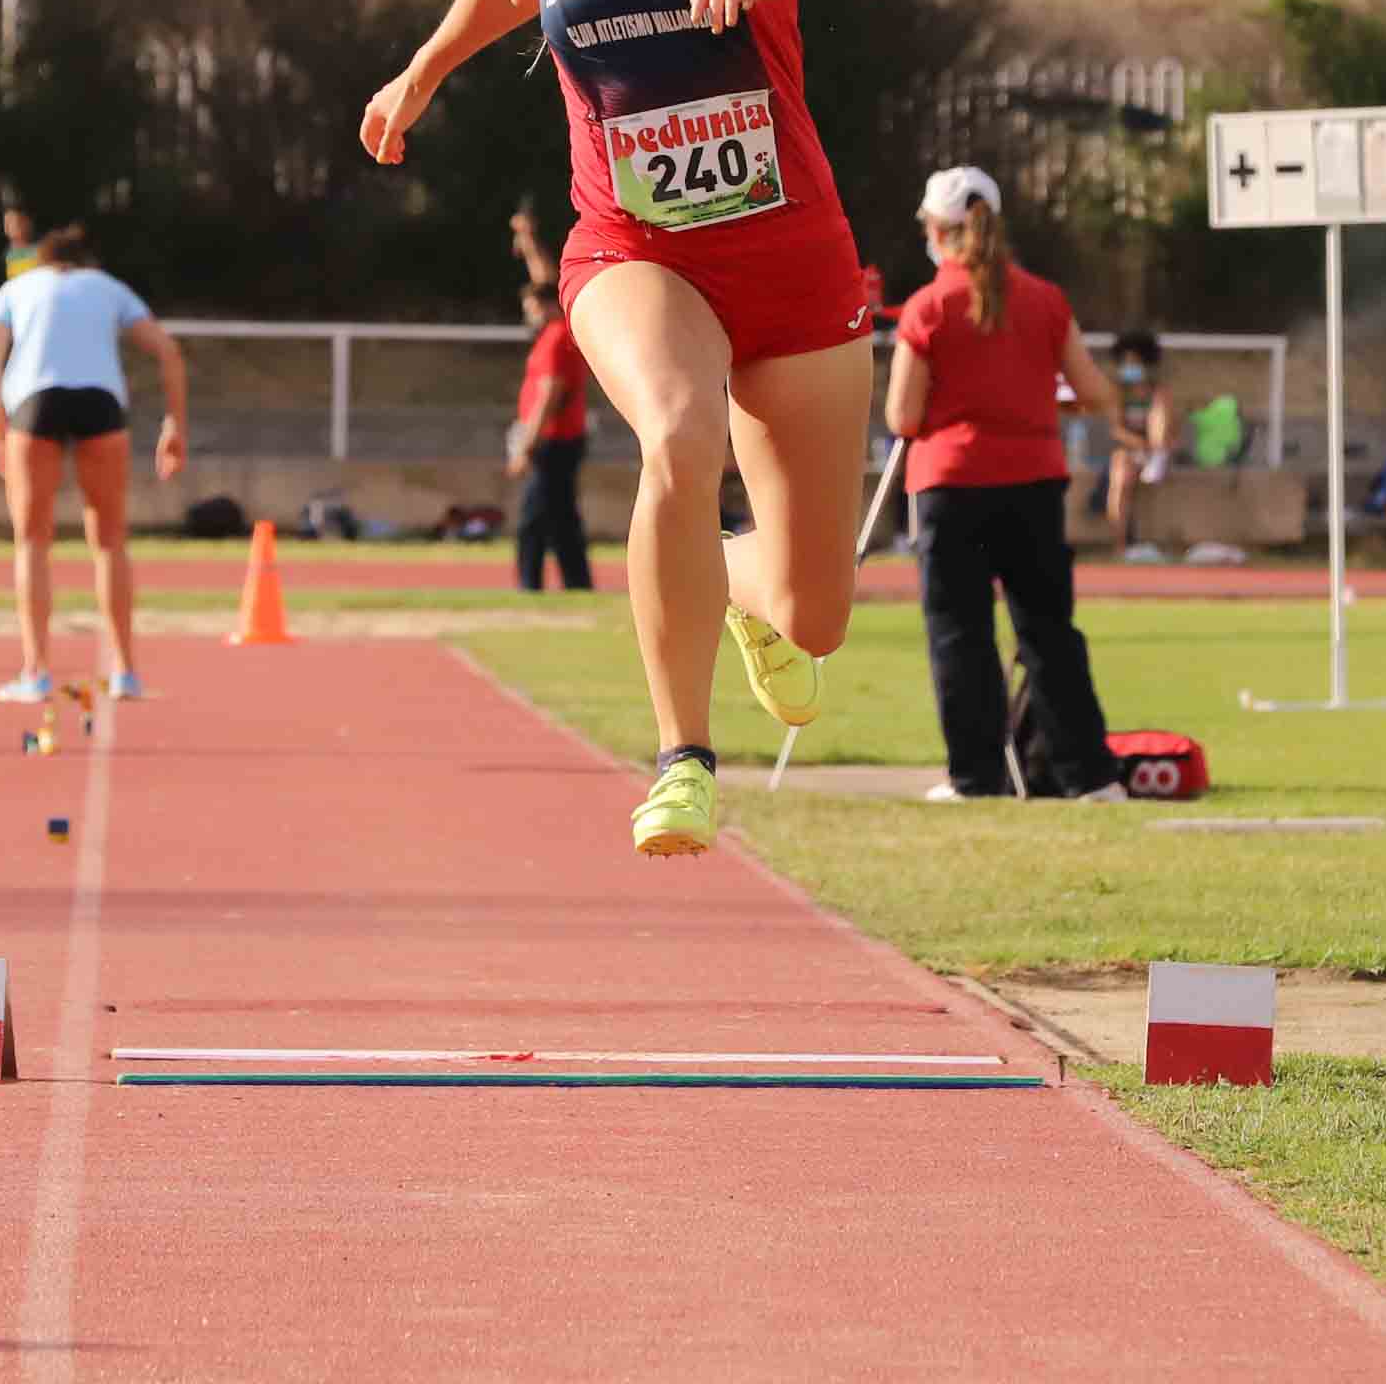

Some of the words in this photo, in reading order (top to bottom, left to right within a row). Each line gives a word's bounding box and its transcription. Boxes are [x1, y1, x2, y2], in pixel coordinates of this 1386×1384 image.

[566, 22, 598, 48] CLUB
[595, 12, 654, 42] ATLETISMO
[610, 100, 771, 161] bedunia
[647, 139, 748, 203] 240
